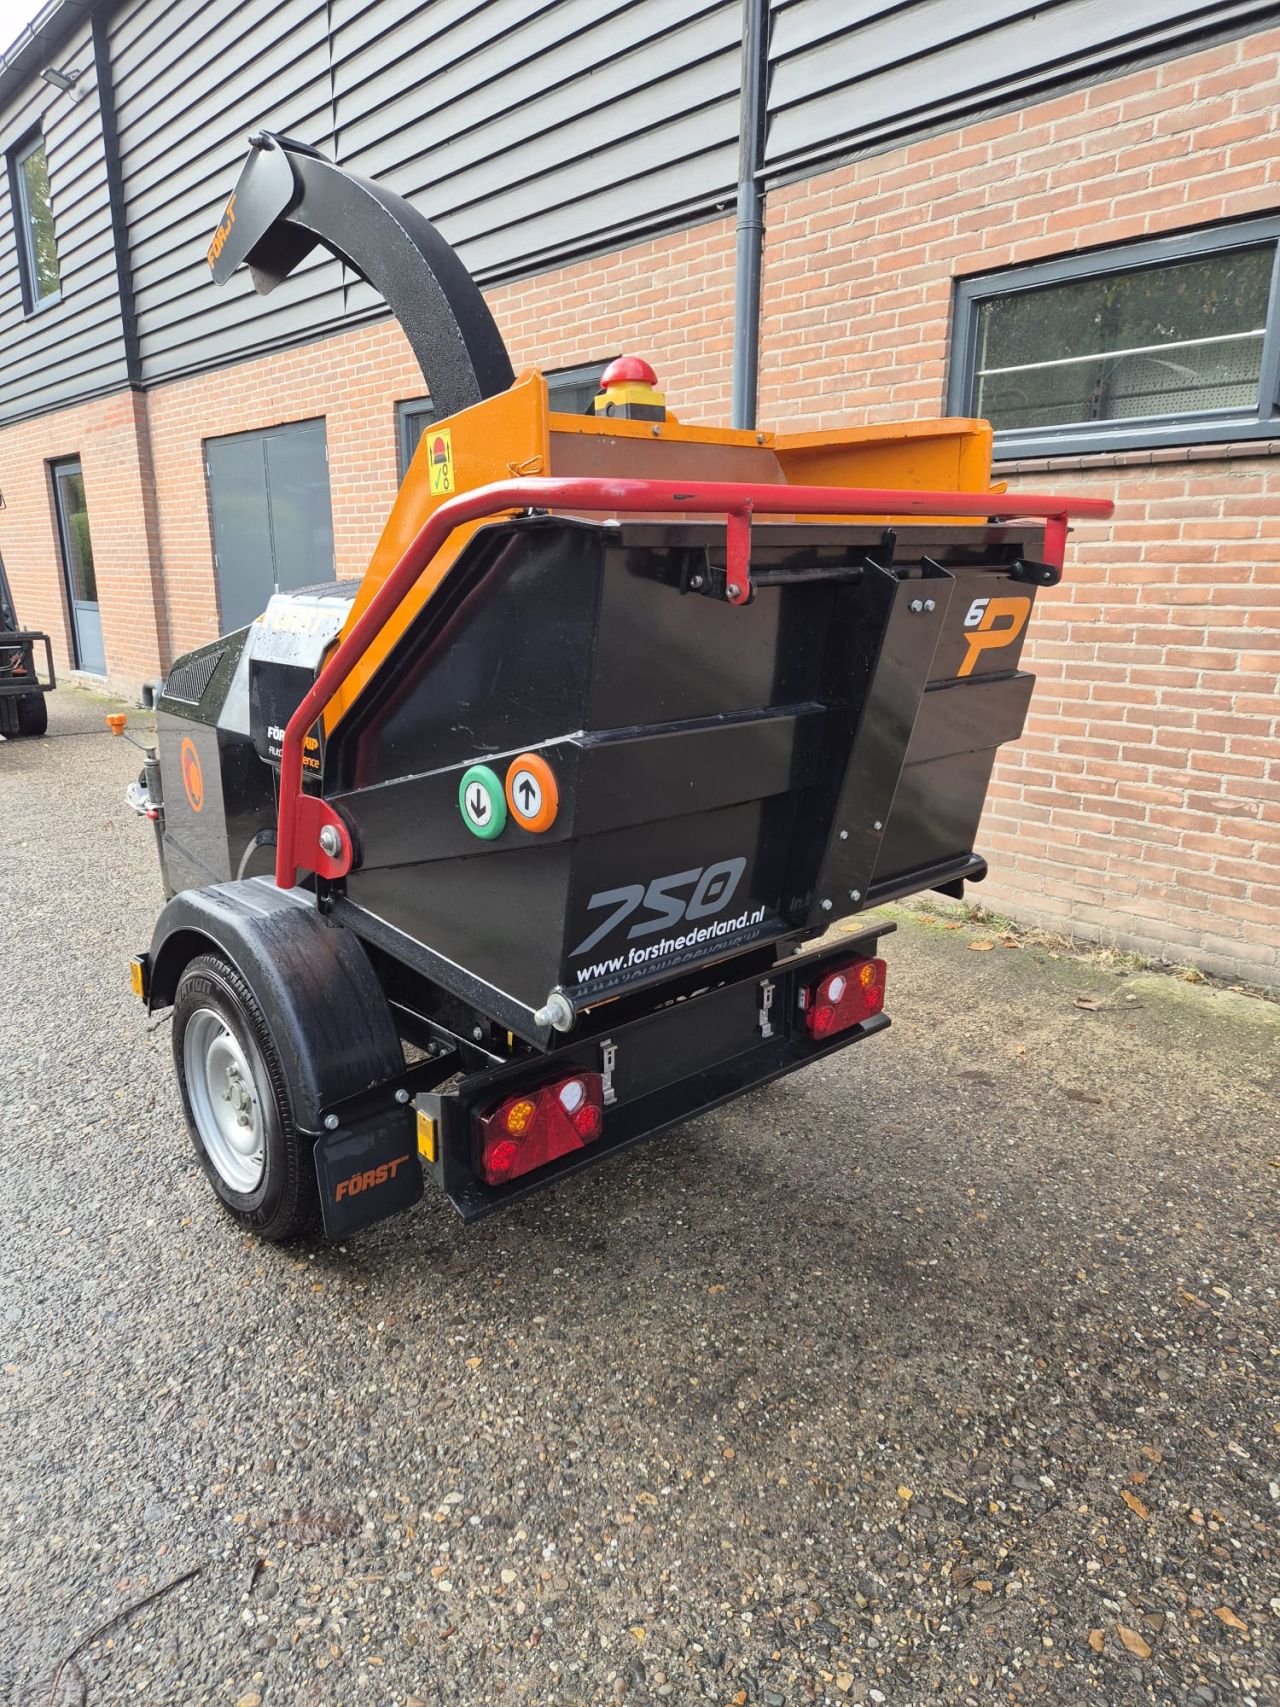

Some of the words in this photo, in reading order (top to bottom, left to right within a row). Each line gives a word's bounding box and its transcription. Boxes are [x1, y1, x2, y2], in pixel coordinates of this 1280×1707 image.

[568, 857, 747, 957] 750
[576, 905, 766, 983] www.forstnederland.nl
[335, 1154, 410, 1202] FÖRST
